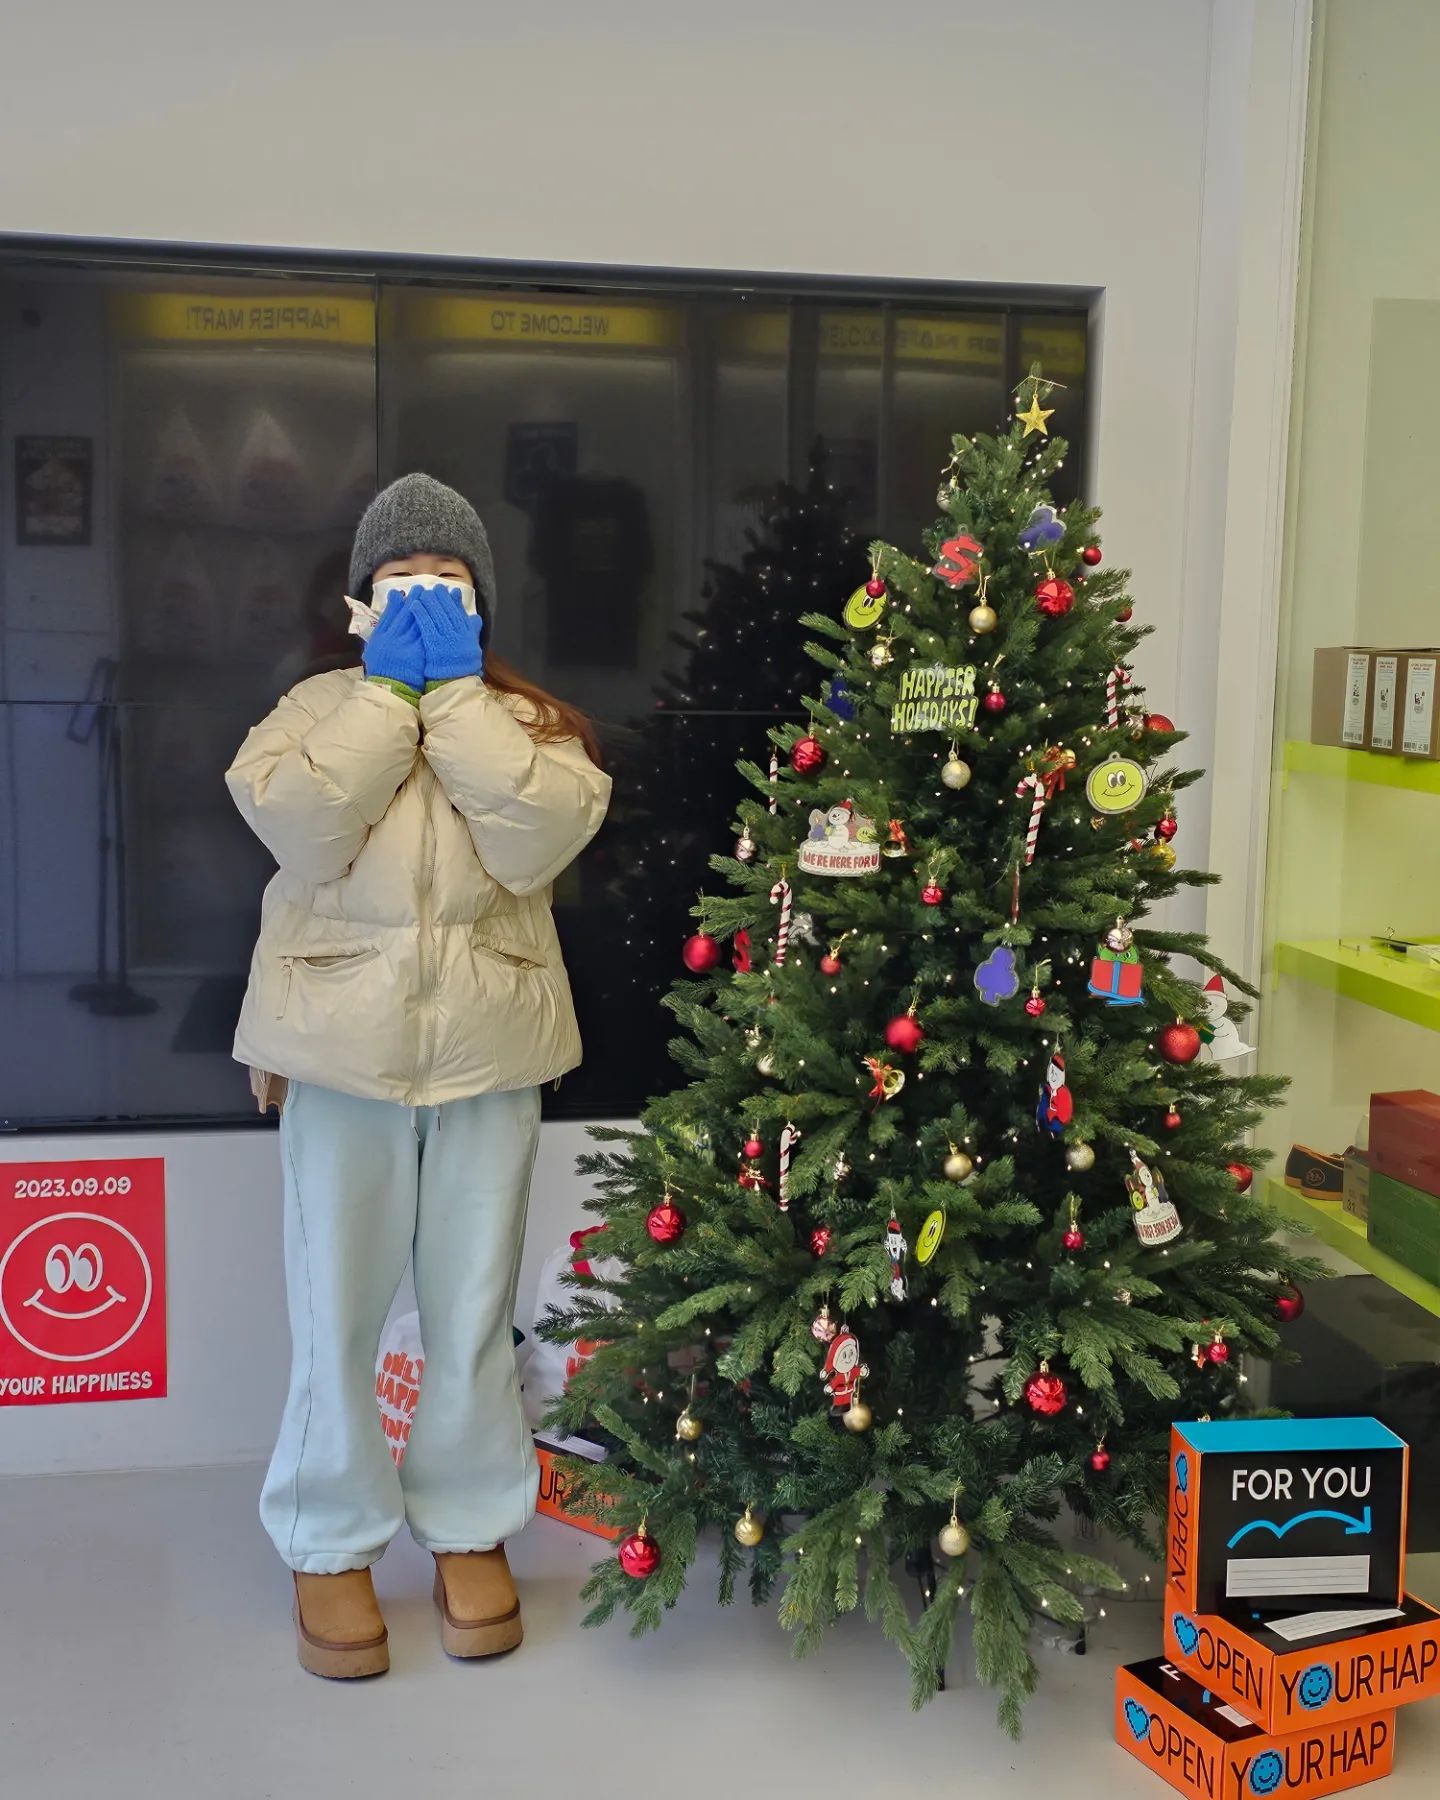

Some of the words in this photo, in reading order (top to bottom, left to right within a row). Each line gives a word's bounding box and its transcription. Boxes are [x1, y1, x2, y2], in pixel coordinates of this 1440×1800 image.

[902, 665, 977, 700] HAPPIER
[892, 698, 978, 733] HOLIDAYS!
[829, 855, 852, 869] HERE
[853, 856, 870, 869] FOR
[871, 853, 878, 866] U
[14, 1176, 132, 1199] 2023.09.09
[0, 1376, 45, 1396] YOUR
[51, 1371, 153, 1395] HAPPINESS
[376, 1372, 420, 1413] HAPP
[1232, 1468, 1293, 1501] FOR
[1301, 1466, 1372, 1499] YOU
[1171, 1485, 1189, 1593] OPEN
[1197, 1627, 1263, 1710] OPEN
[1380, 1639, 1438, 1693] HAP
[1148, 1713, 1215, 1799] OPEN
[1329, 1720, 1388, 1777] HAP
